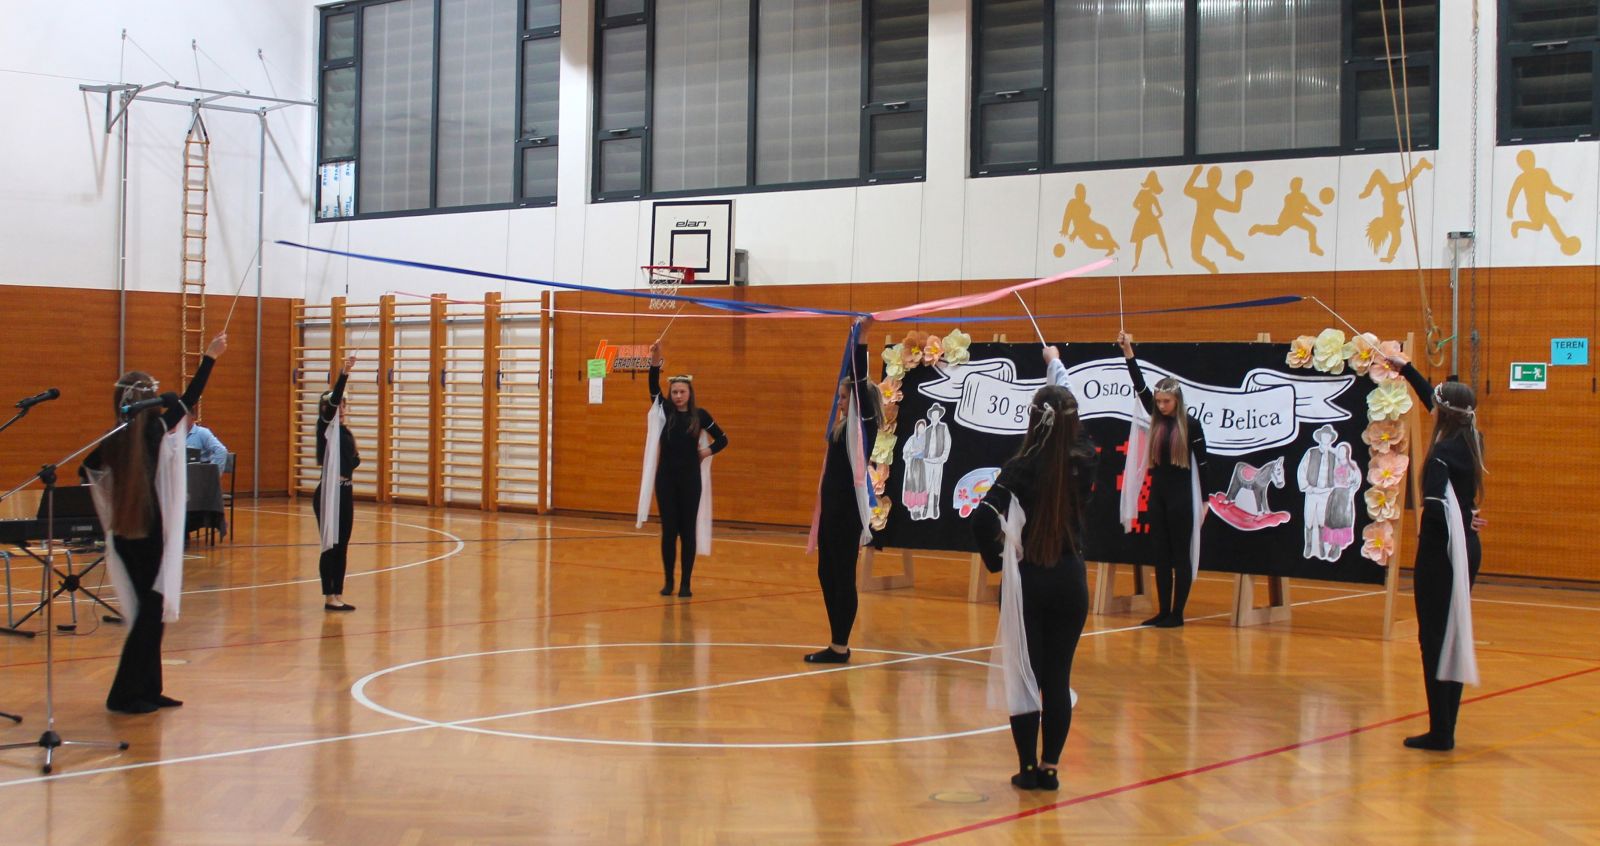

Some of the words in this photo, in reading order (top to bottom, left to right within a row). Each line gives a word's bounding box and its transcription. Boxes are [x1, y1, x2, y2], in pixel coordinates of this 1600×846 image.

[675, 219, 707, 228] elan
[1555, 341, 1585, 349] TEREN
[987, 395, 1010, 415] 30
[1186, 402, 1214, 425] ole
[1219, 407, 1282, 431] Belica
